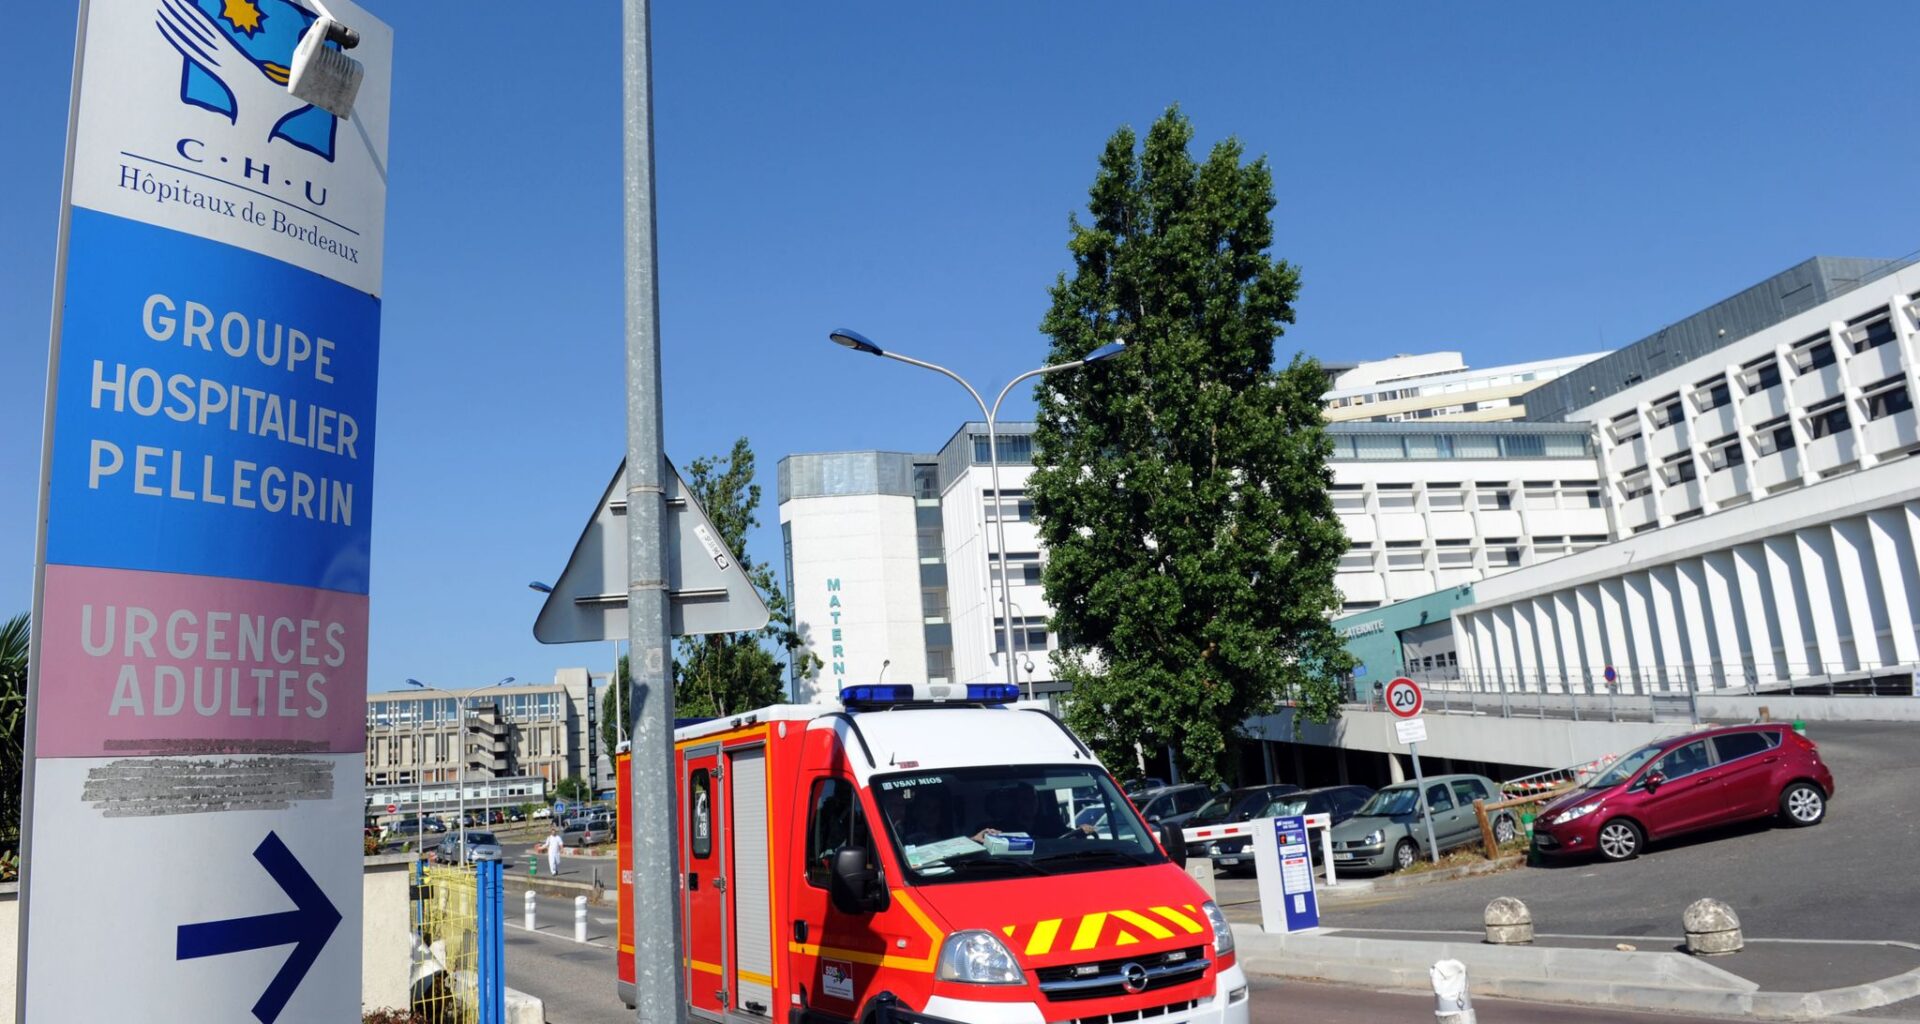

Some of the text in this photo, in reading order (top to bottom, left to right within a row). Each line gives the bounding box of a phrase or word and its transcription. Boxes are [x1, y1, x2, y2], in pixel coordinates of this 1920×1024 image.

[119, 164, 359, 264] Hôpitaux de Bordeaux
[142, 294, 336, 384] GROUPE
[90, 359, 359, 459] HOSPITALIER
[88, 439, 353, 526] PELLEGRIN
[81, 604, 346, 667] URGENCES
[108, 664, 329, 718] ADULTES
[1394, 689, 1415, 707] 20
[892, 776, 942, 789] VSAV MIOS
[698, 822, 708, 837] 18
